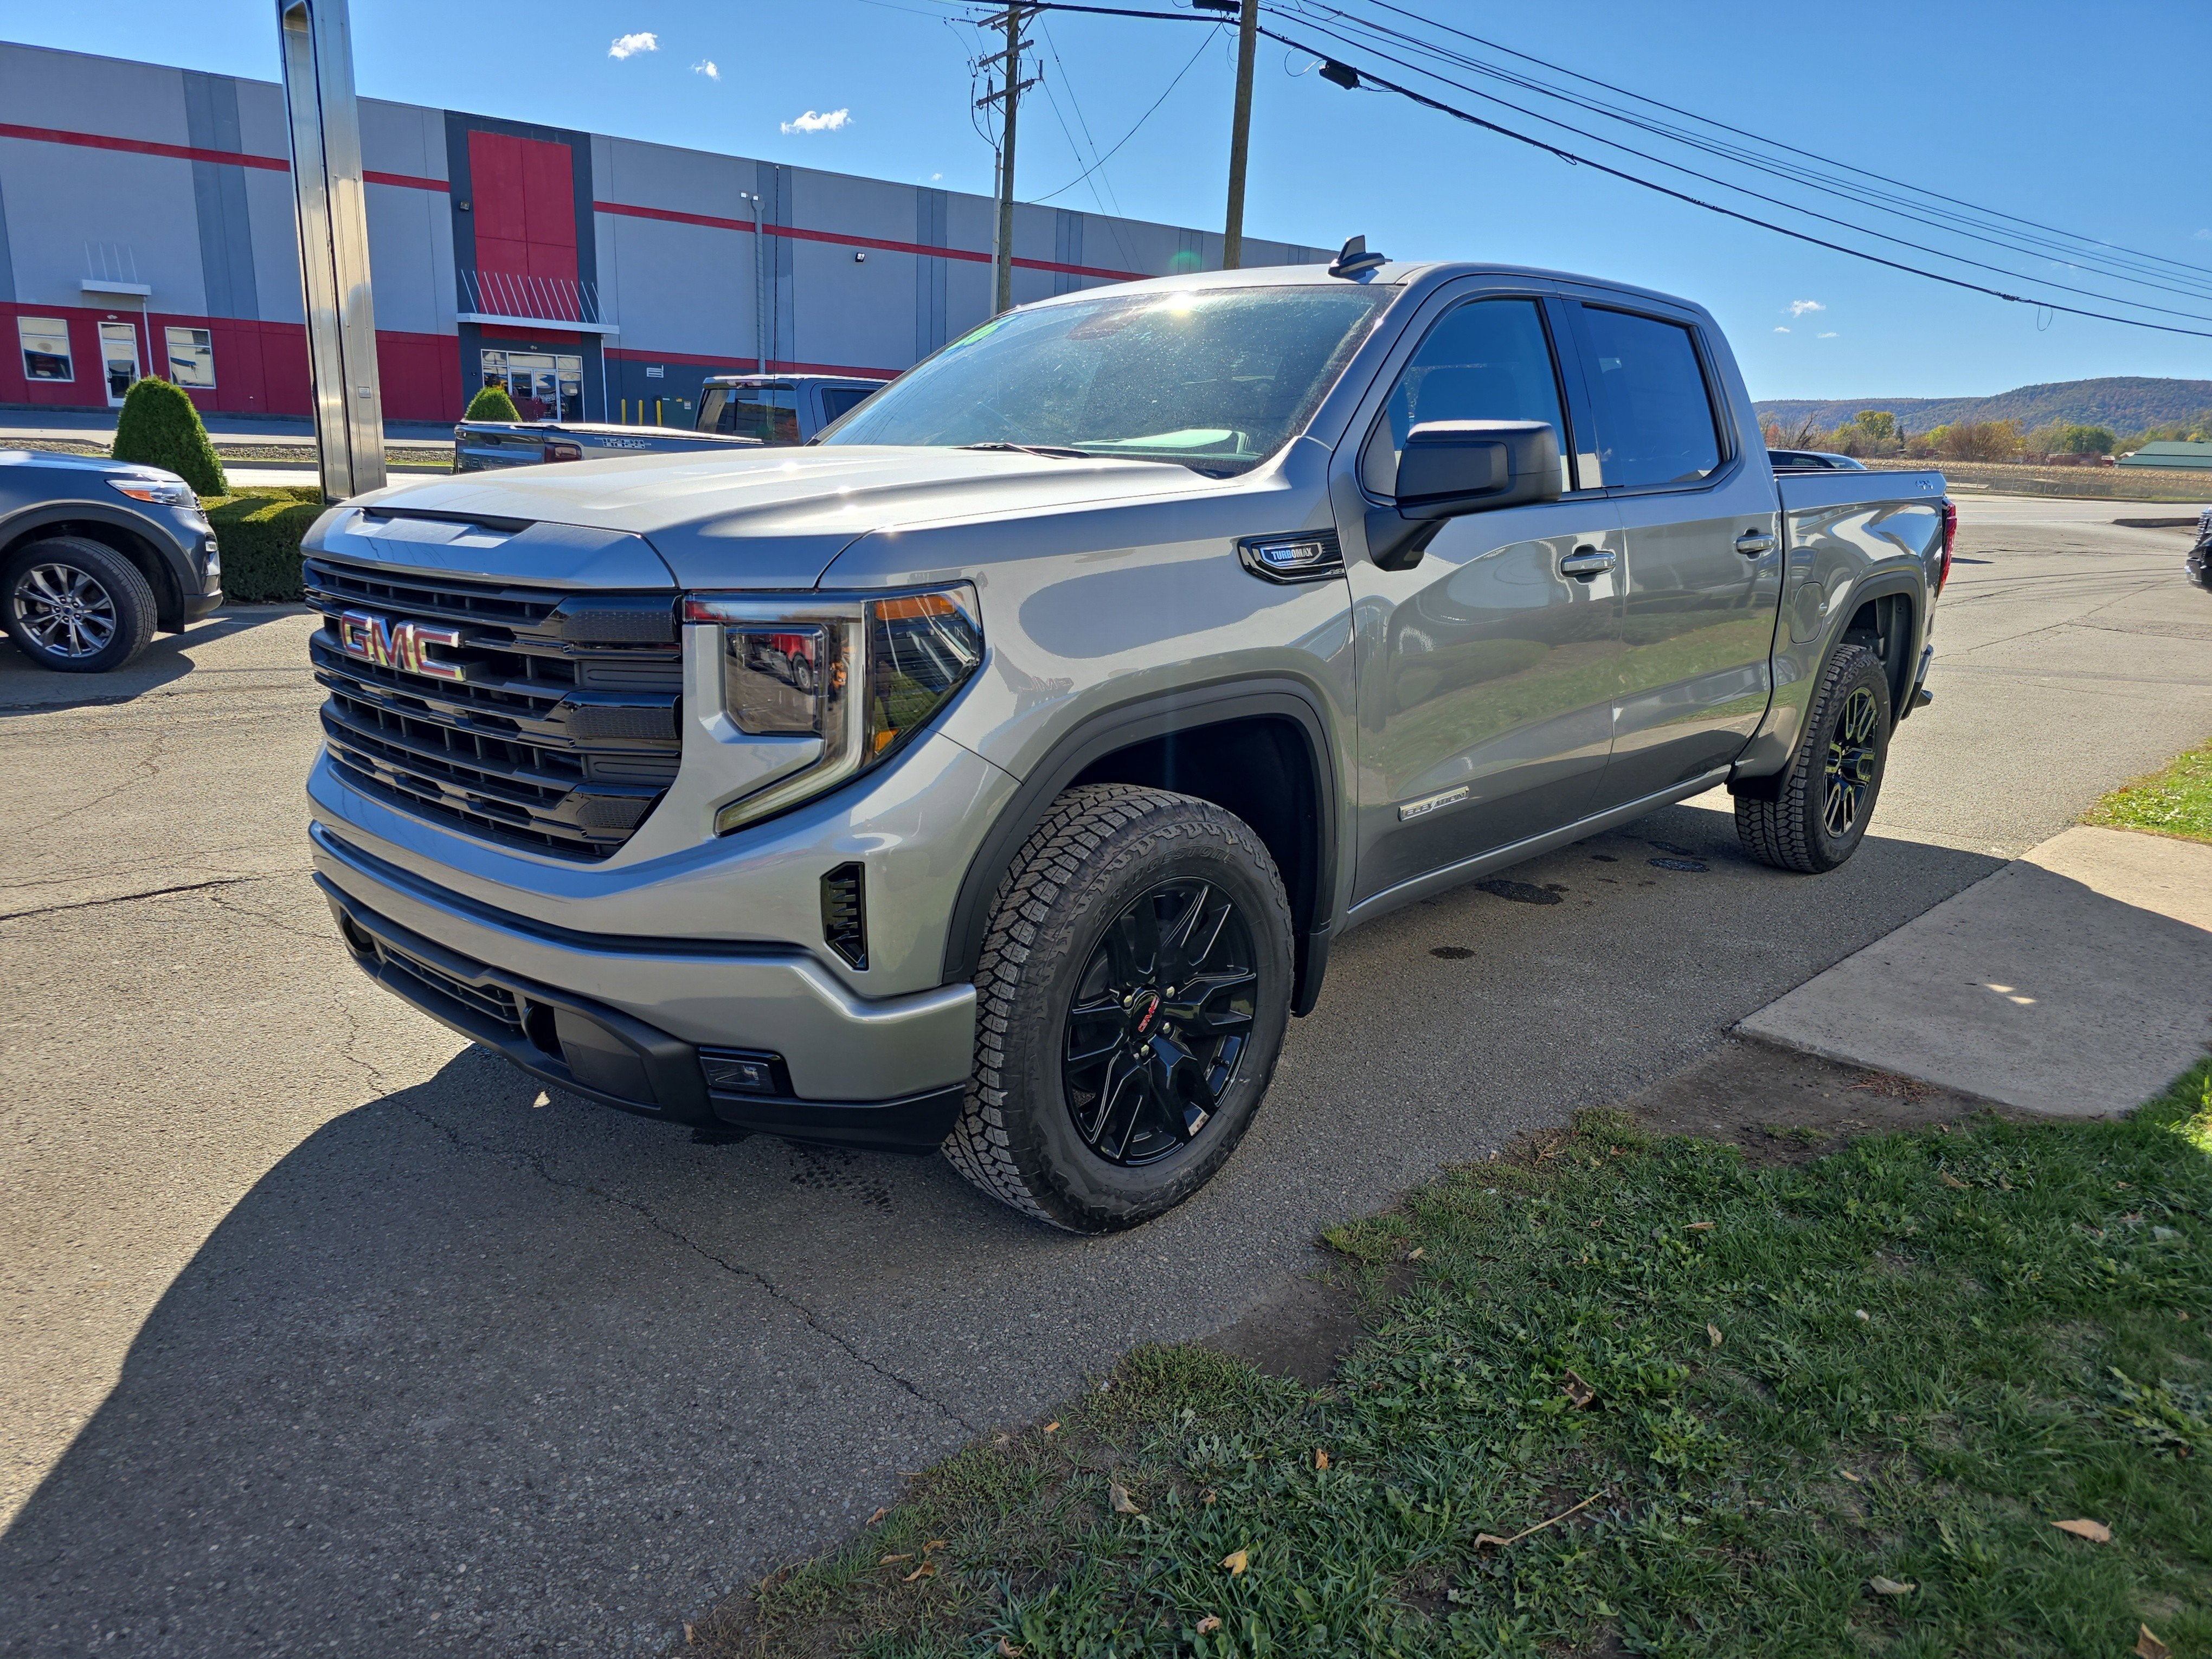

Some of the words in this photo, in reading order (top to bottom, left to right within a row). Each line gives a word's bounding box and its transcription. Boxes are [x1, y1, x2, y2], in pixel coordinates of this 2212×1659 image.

[1271, 548, 1313, 560] TURBOMAX
[340, 610, 466, 681] GMC
[1094, 844, 1238, 928] BRIDGESTONE
[1137, 997, 1160, 1032] GMC
